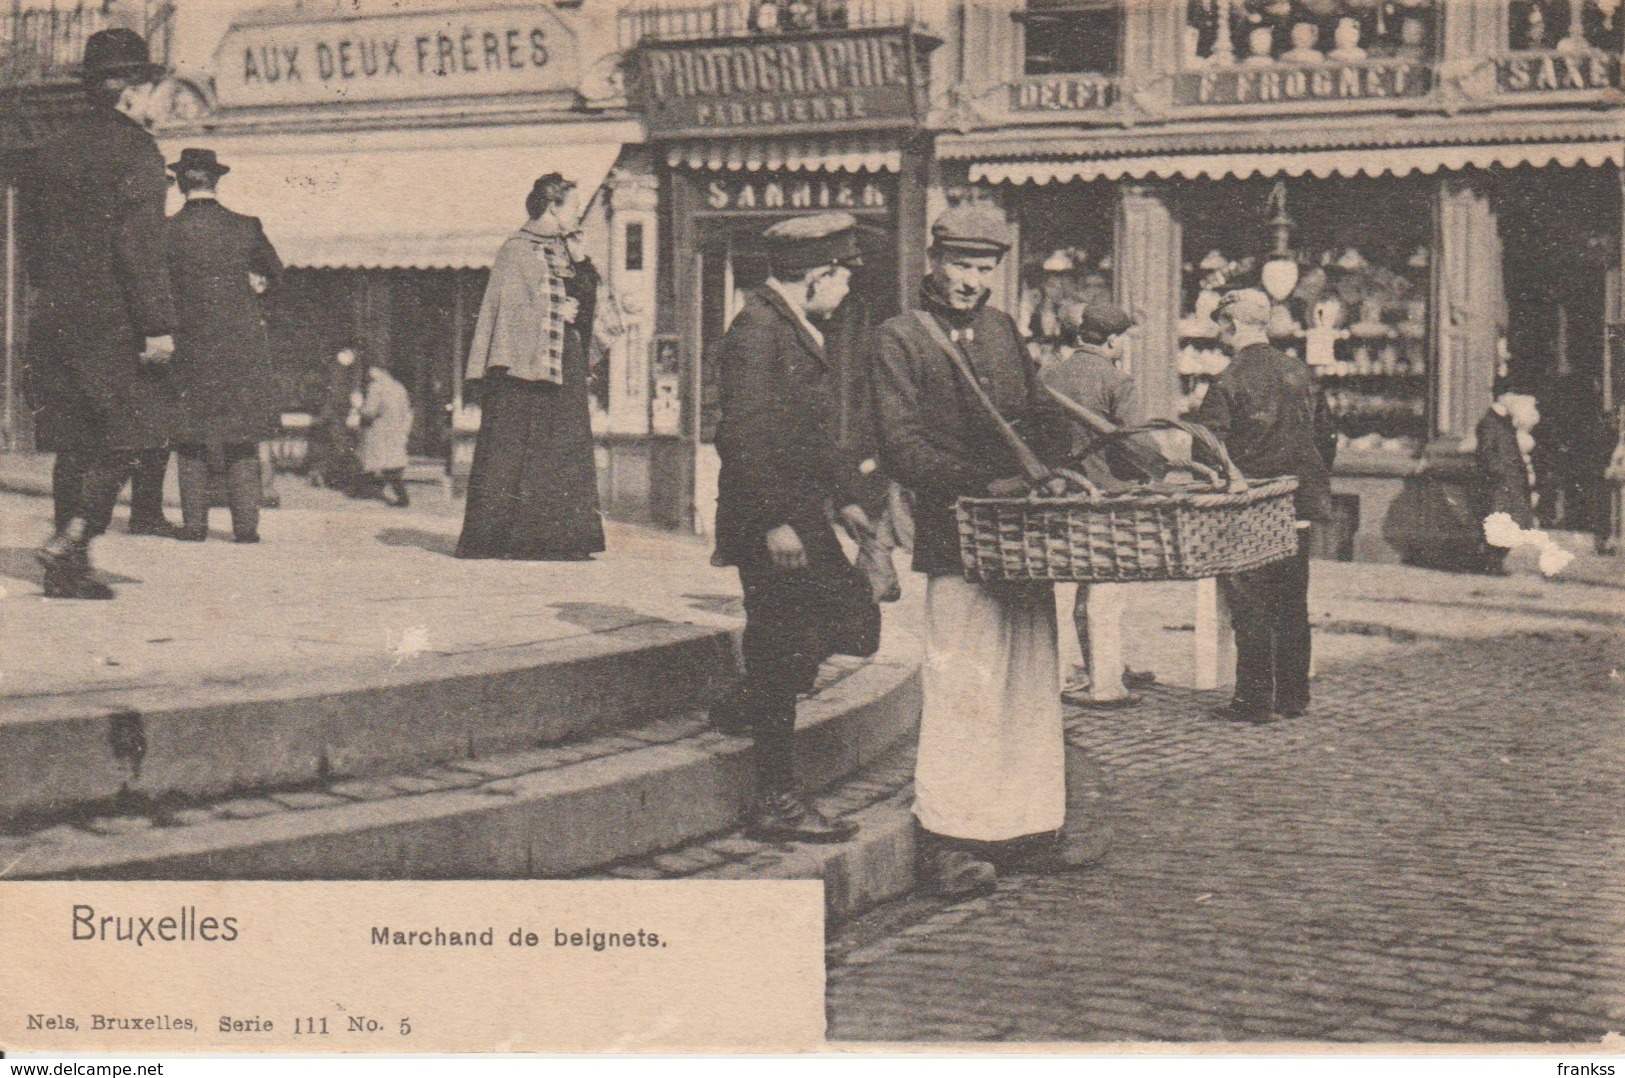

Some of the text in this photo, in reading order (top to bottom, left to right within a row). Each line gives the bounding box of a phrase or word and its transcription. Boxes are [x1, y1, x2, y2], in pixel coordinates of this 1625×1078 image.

[243, 45, 301, 83] AUX
[315, 39, 401, 80] DEUX
[652, 38, 907, 97] PHOTOGRAPHIE
[1019, 80, 1113, 108] DELFT
